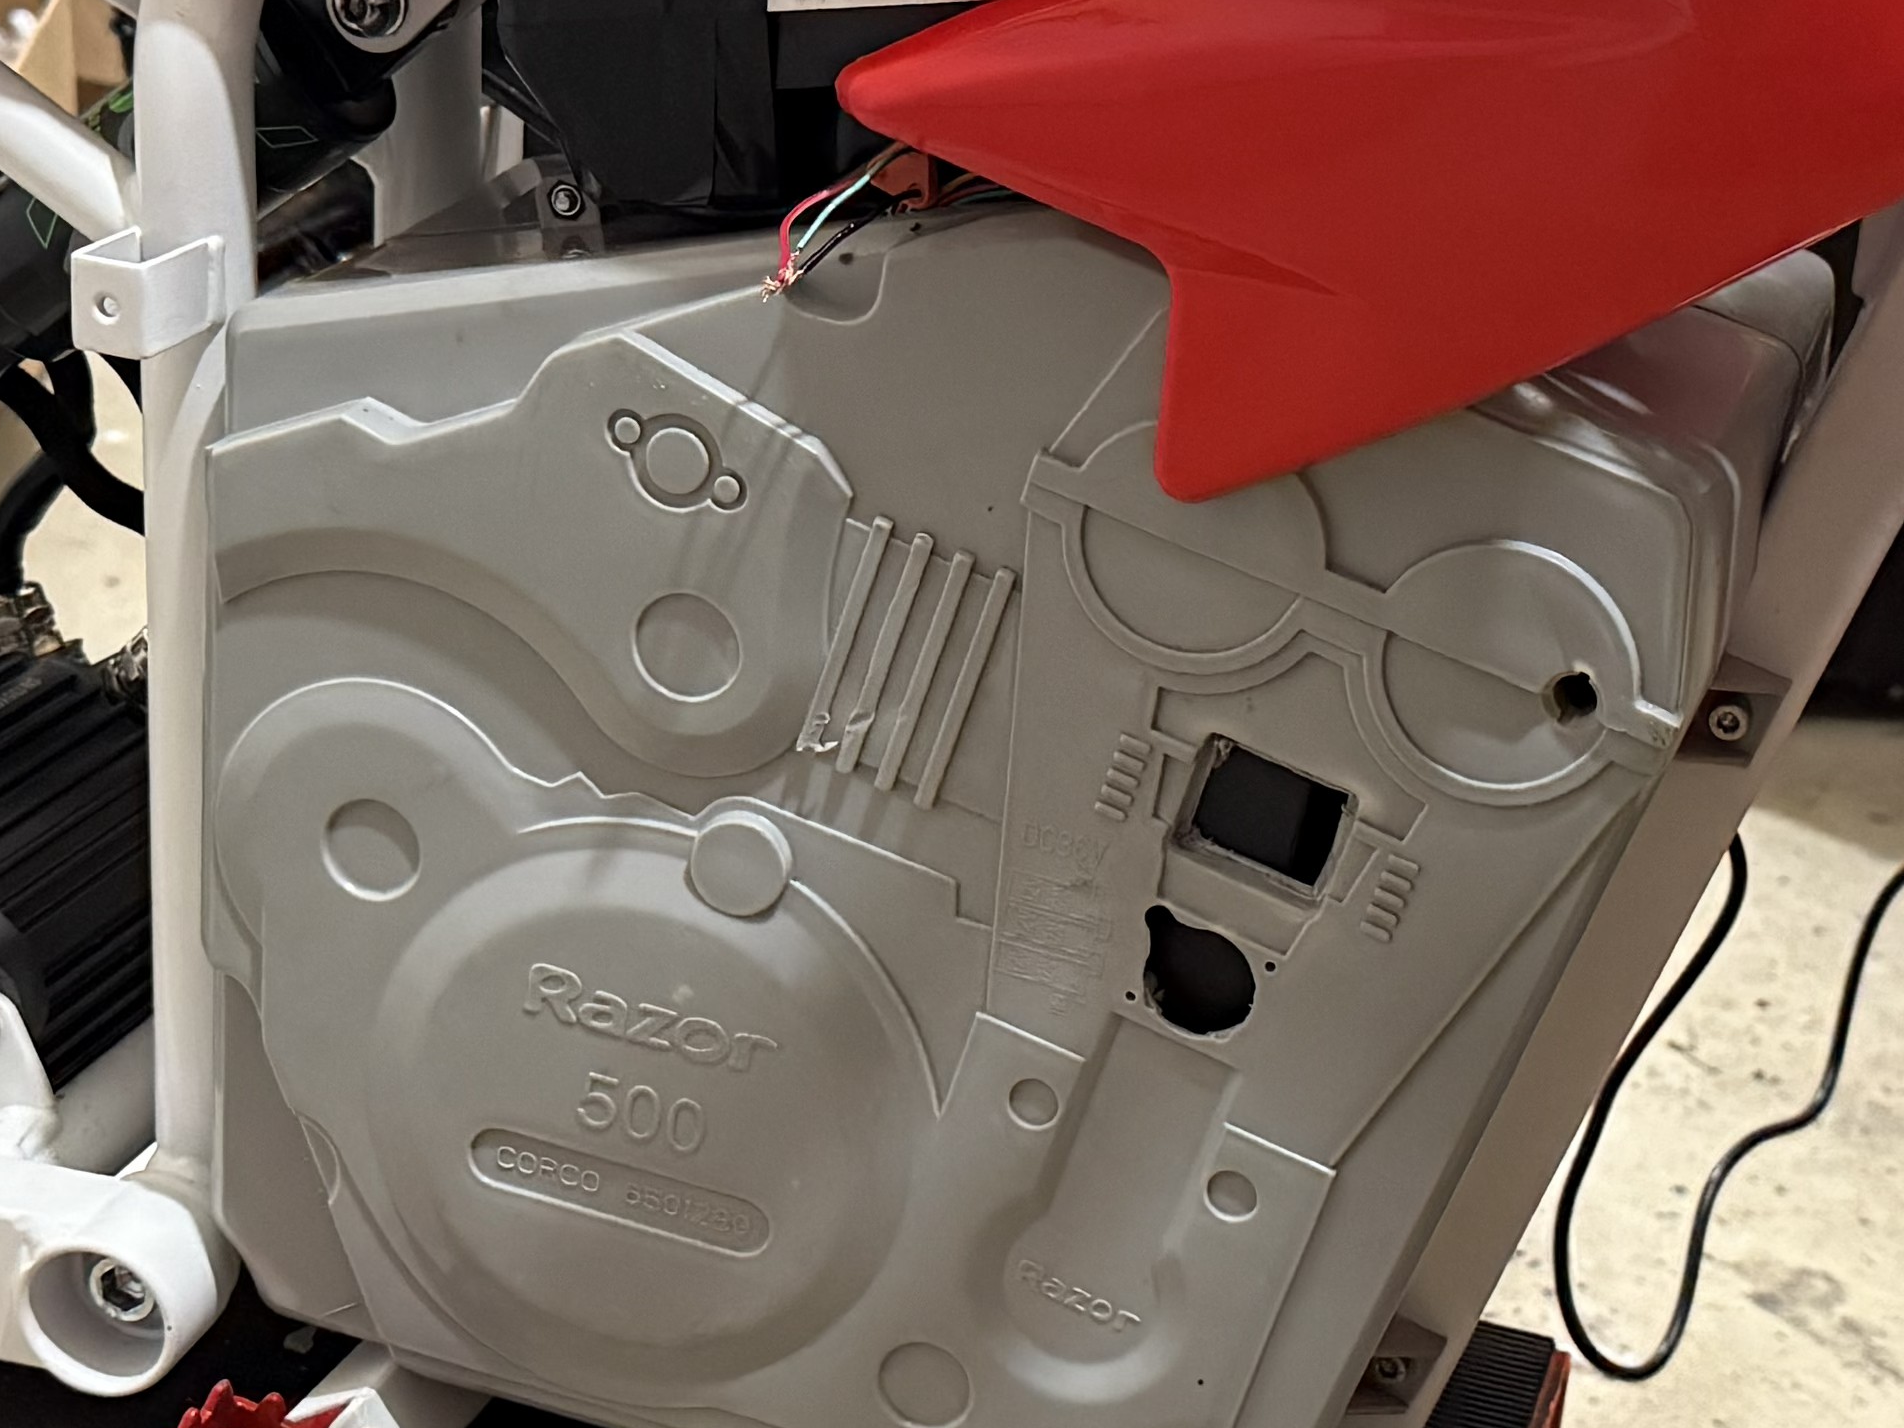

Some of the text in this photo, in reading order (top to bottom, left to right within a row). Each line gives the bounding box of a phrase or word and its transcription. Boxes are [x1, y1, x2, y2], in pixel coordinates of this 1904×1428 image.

[522, 962, 778, 1074] Razor
[574, 1071, 707, 1154] 500
[1014, 1256, 1143, 1337] Razor
